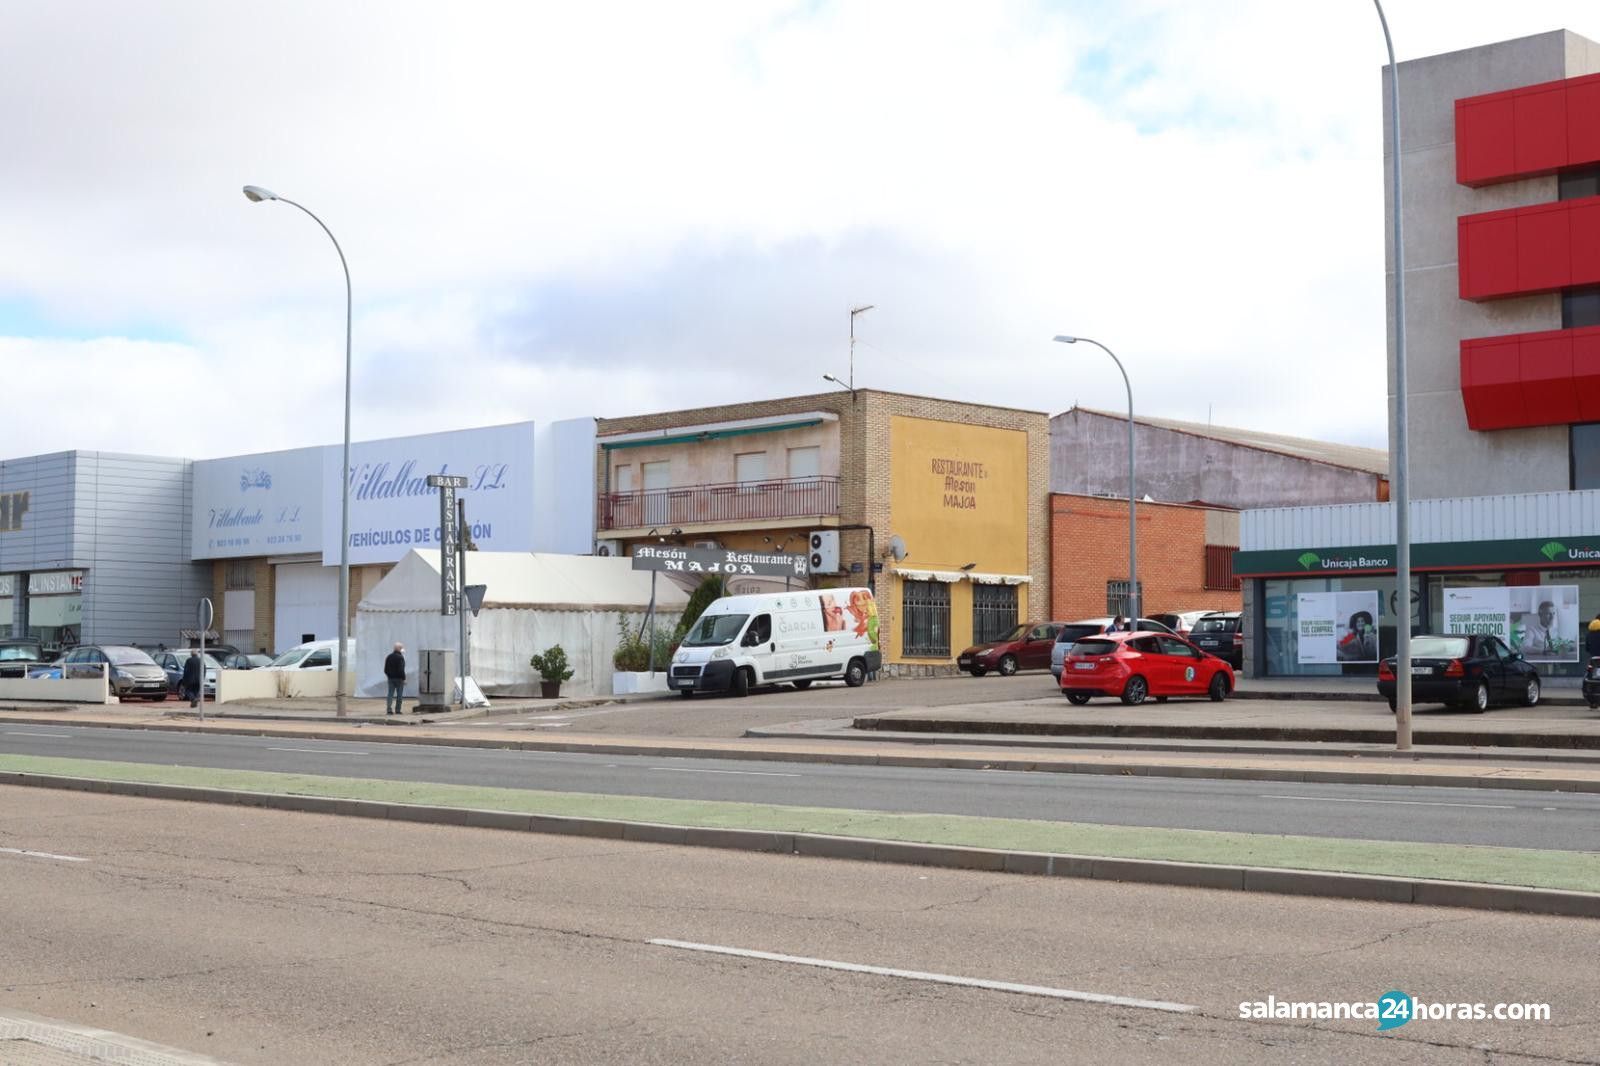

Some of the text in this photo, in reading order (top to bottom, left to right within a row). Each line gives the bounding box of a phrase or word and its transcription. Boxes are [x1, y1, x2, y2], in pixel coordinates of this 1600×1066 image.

[931, 458, 983, 478] RESTAURANTE
[437, 476, 461, 486] BAR
[943, 494, 977, 509] MAJOA
[414, 528, 430, 544] DE
[444, 488, 456, 614] RESTAURANTE
[636, 547, 793, 565] Mesón Restaurante
[664, 560, 756, 574] MAJOA
[1322, 557, 1389, 570] Unicaja Banco
[1472, 612, 1506, 622] APOYANDO
